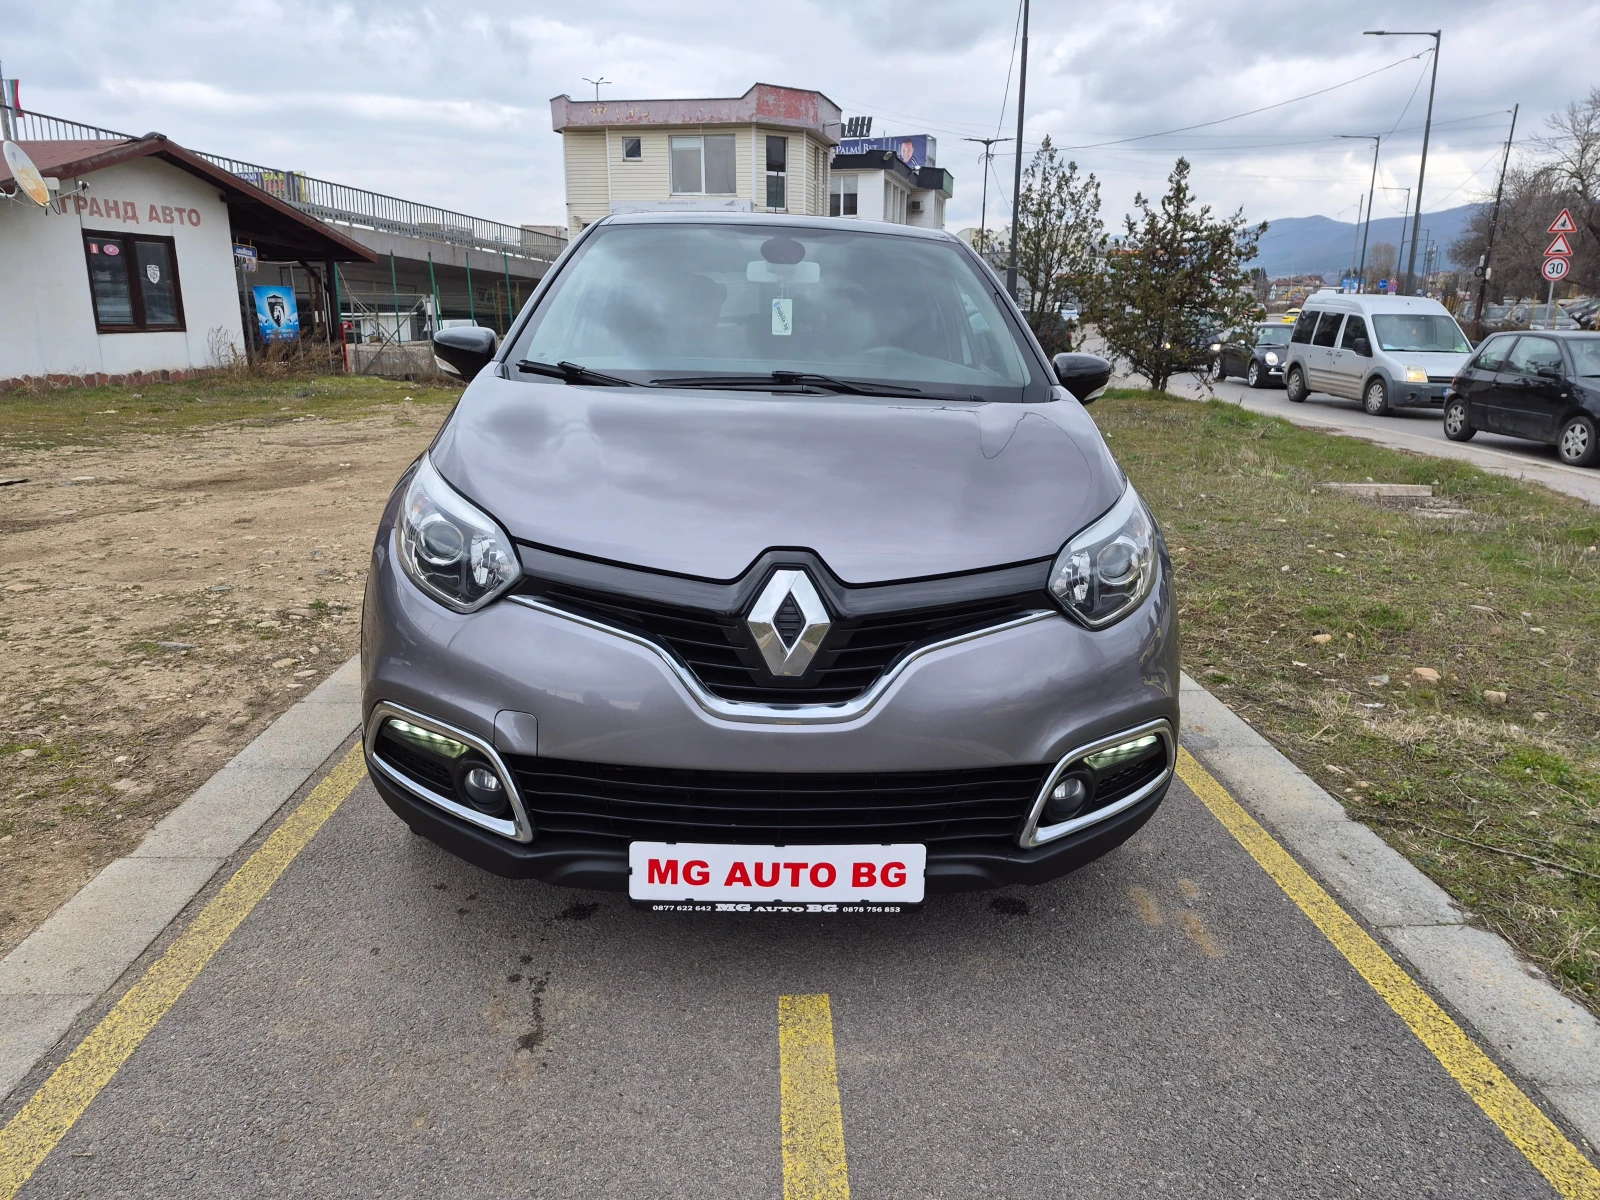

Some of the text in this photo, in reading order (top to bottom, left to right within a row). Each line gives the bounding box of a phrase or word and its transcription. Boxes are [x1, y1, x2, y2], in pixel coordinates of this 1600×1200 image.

[59, 194, 201, 227] ГРАНД АВТО
[1548, 262, 1564, 274] 30
[647, 858, 907, 888] MG AUTO BG
[715, 903, 752, 912] MG
[806, 903, 839, 913] BG
